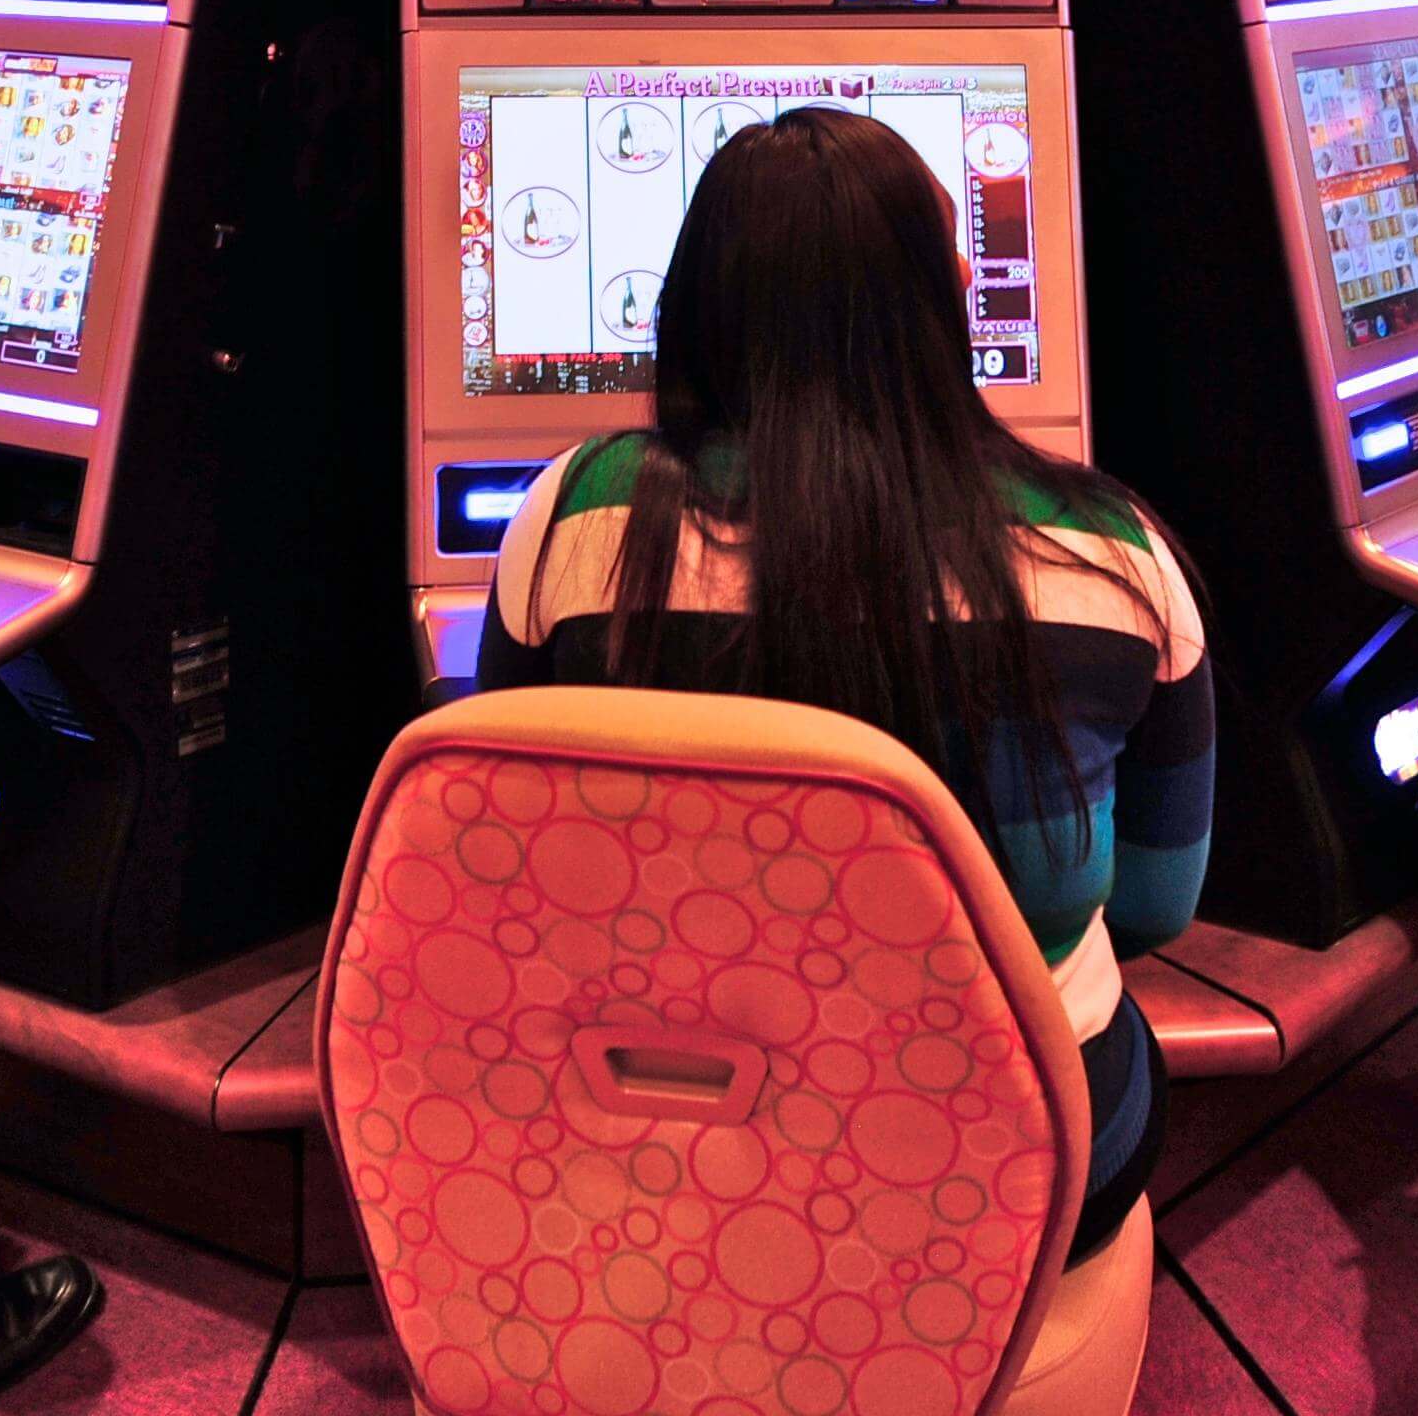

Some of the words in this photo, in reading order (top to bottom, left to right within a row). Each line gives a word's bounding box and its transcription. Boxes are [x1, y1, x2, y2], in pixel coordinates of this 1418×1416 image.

[583, 71, 610, 97] A
[612, 71, 713, 97] Perfect
[716, 71, 821, 97] Present
[919, 78, 942, 91] Spin
[942, 77, 953, 90] 2
[954, 78, 965, 89] of
[1007, 266, 1029, 279] 200
[971, 320, 1036, 333] VALUES
[36, 350, 45, 364] 0
